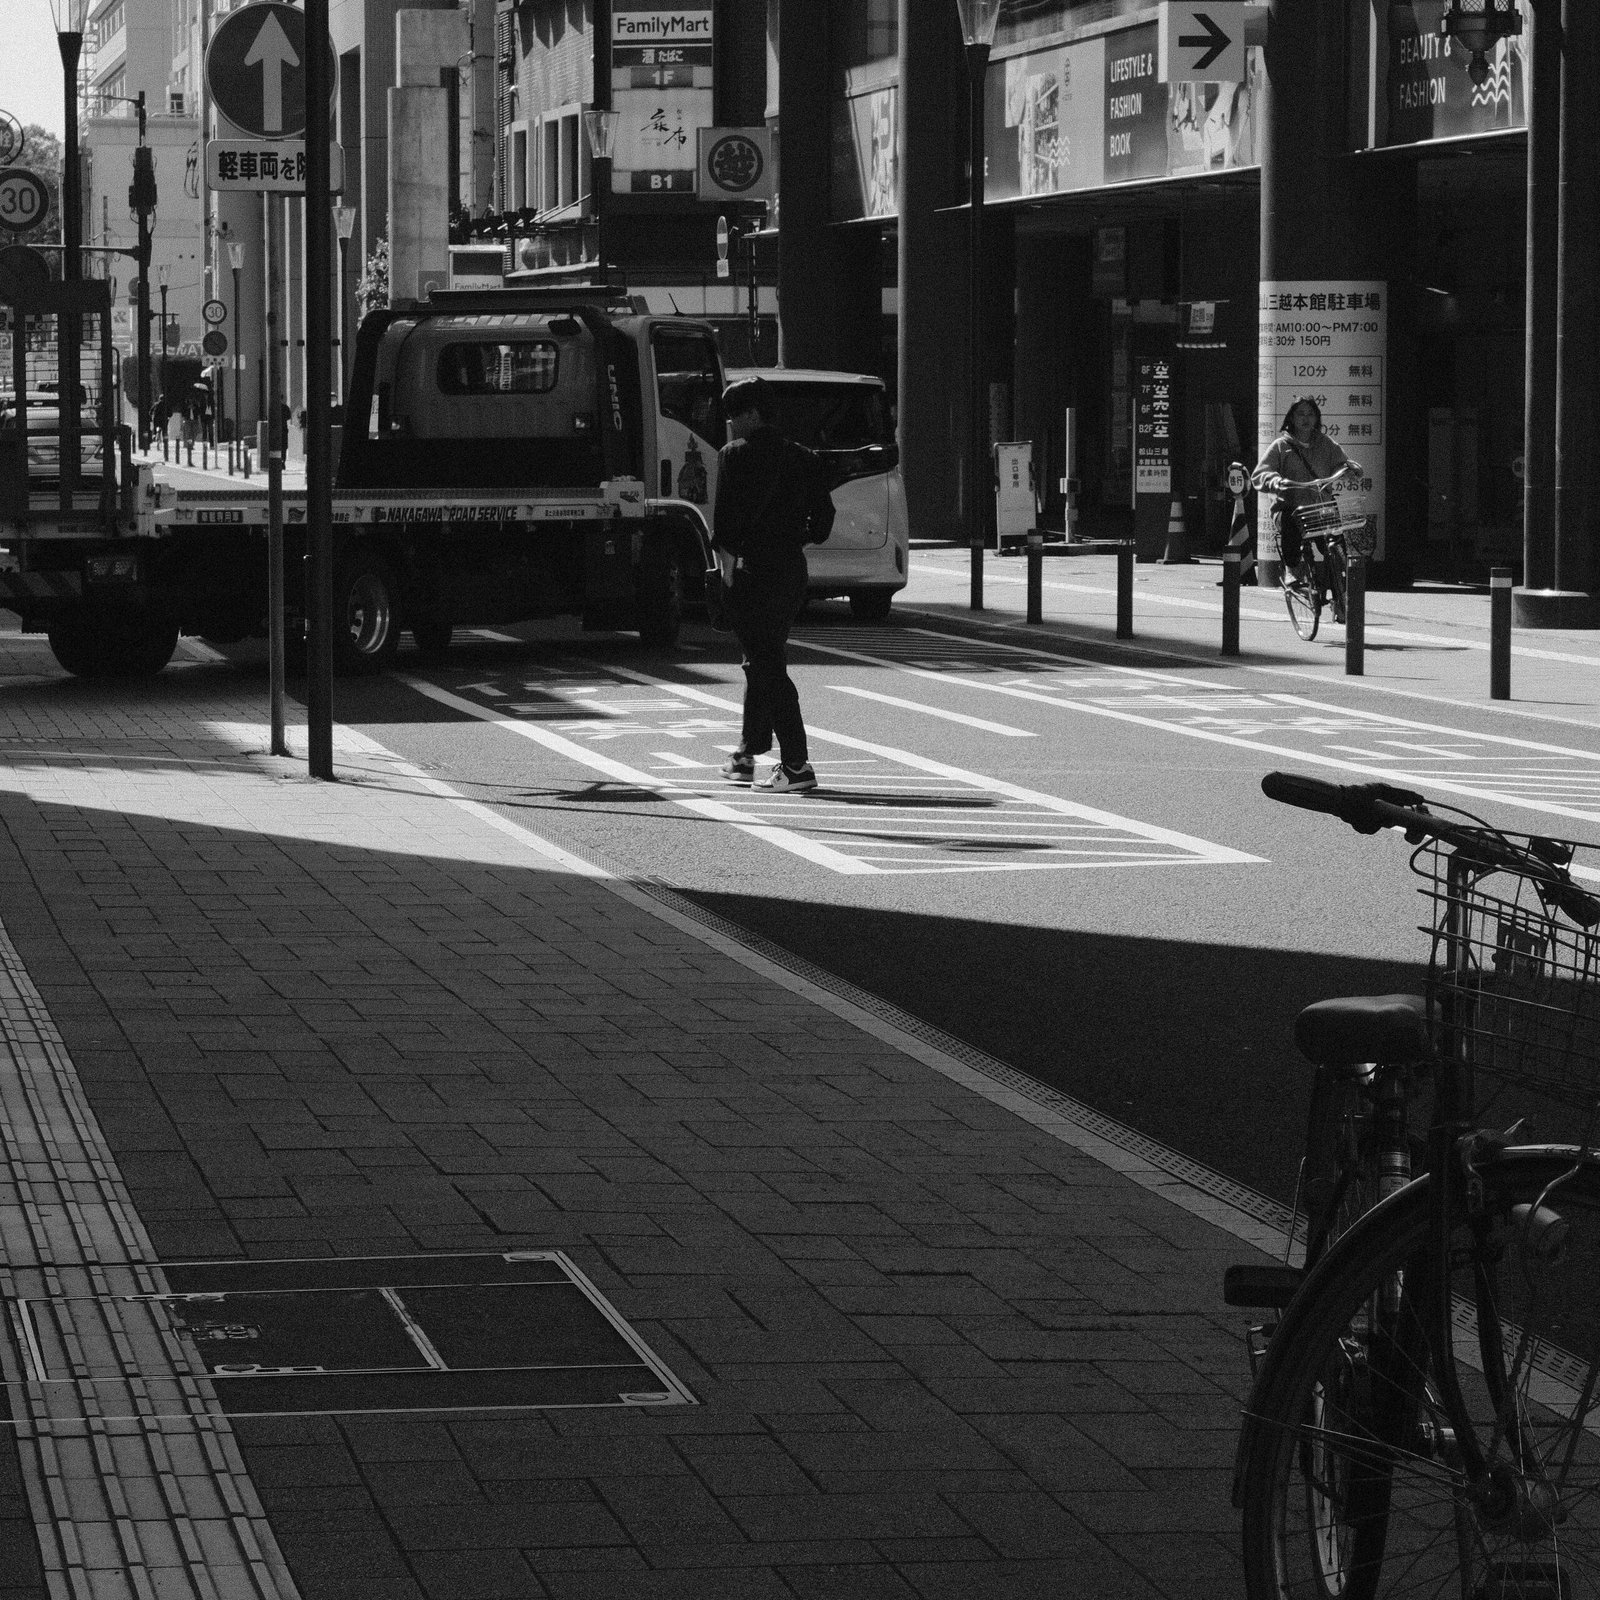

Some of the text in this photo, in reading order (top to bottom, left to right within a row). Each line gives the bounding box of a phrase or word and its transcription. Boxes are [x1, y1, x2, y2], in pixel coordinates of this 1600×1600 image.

[617, 16, 709, 37] FamilyMart
[1400, 33, 1451, 64] BEAUTY &
[642, 49, 684, 64] 酒 たばこ
[1110, 53, 1152, 83] LIFESTYLE &
[652, 70, 675, 85] 1F
[1400, 77, 1446, 109] FASHION
[1110, 93, 1142, 119] FASHION
[1110, 132, 1131, 157] BOOK
[650, 174, 673, 189] B1
[1, 187, 35, 214] 30
[207, 306, 223, 319] 30
[1300, 335, 1331, 347] 150円
[1293, 365, 1373, 377] 120分 無料
[1141, 384, 1150, 393] 7F
[1348, 394, 1373, 407] 無料
[1139, 424, 1153, 433] B2F
[1348, 424, 1373, 436] 無料
[387, 506, 518, 522] NAKAGAWA ROAD SERVICE
